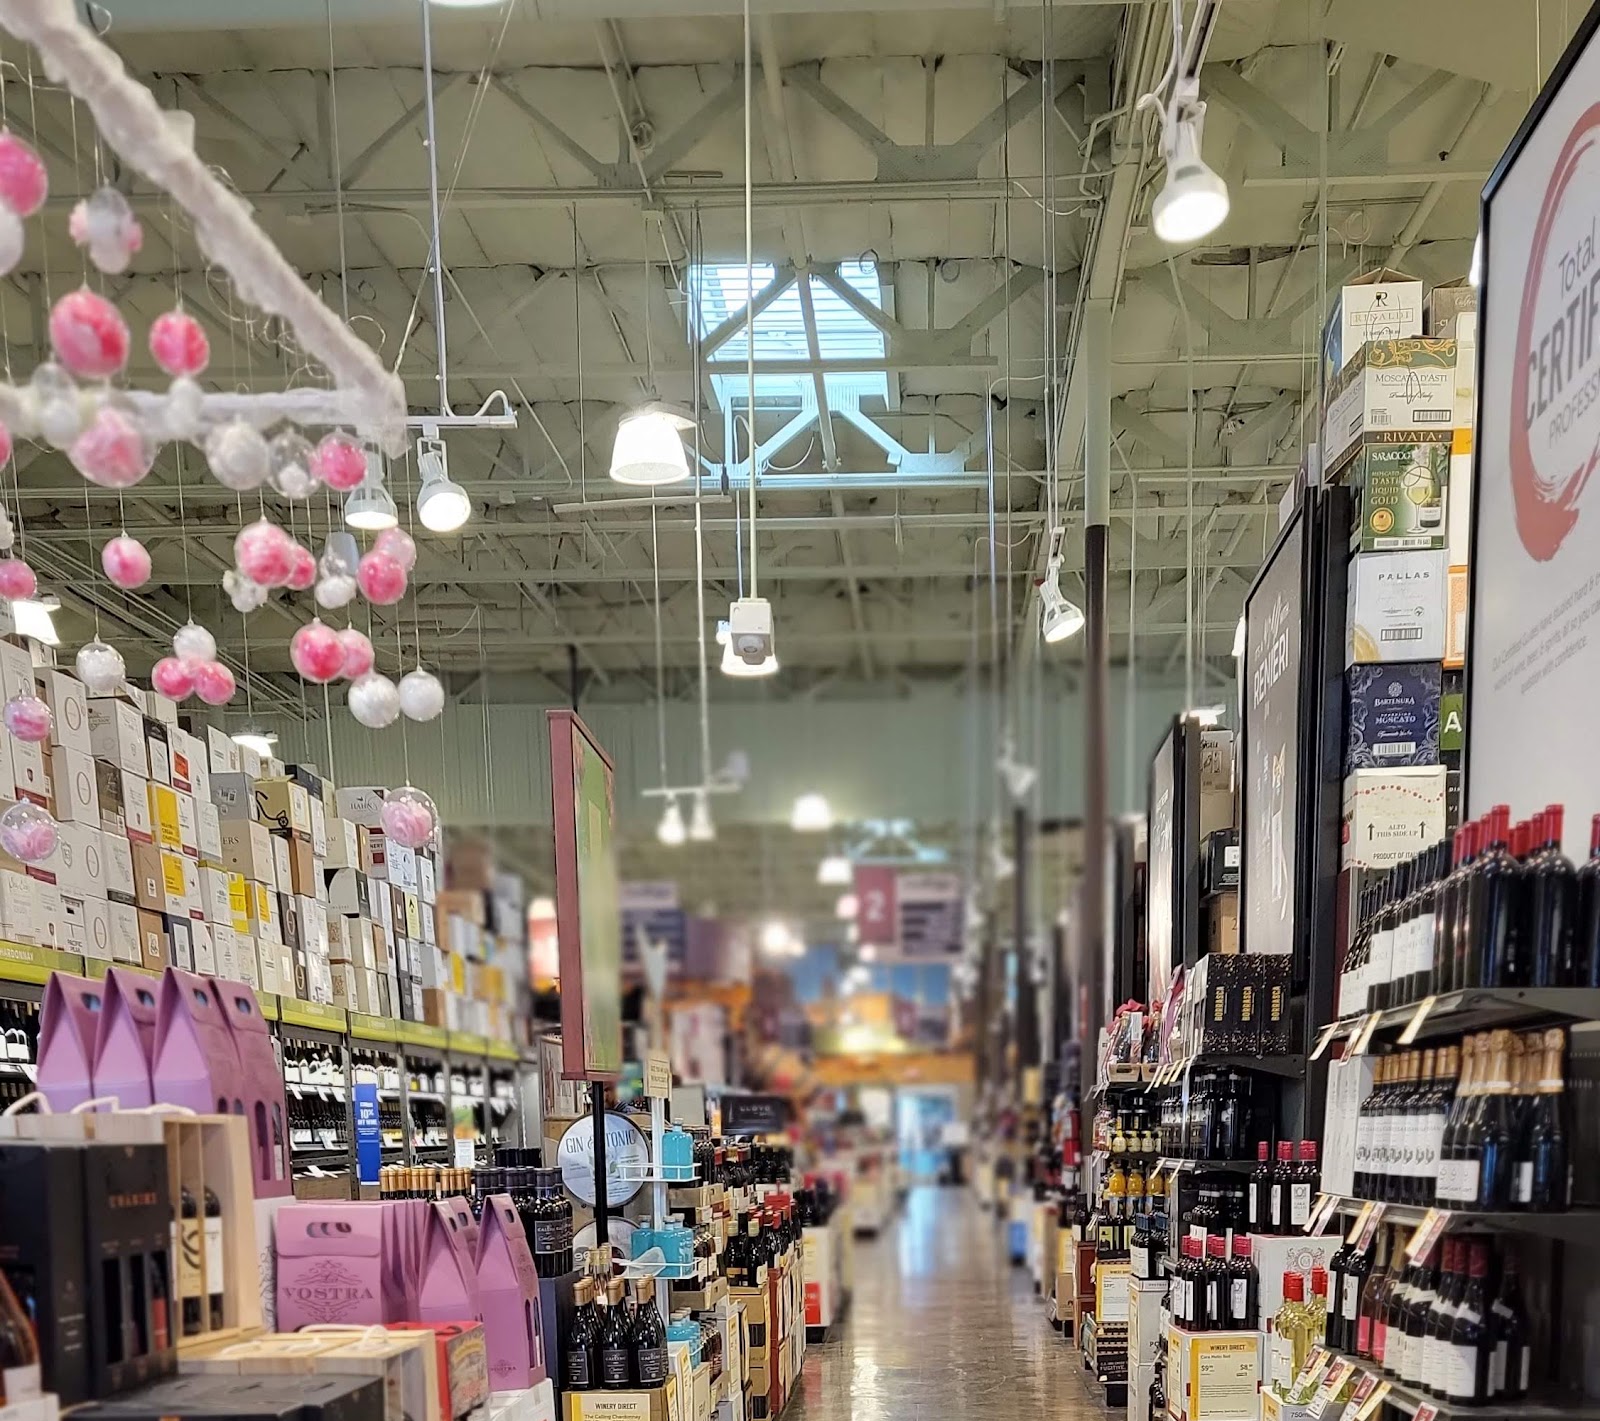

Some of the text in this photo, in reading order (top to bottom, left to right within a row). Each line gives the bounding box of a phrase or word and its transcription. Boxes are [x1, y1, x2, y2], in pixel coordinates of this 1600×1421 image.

[1558, 216, 1596, 300] Total
[1355, 310, 1410, 323] RINALDI
[1375, 373, 1448, 383] MOSCATO D'ASTI
[1383, 431, 1437, 442] RIVATA
[1371, 477, 1400, 485] D'ASTI
[1371, 487, 1399, 495] LIQUID
[1370, 496, 1399, 505] GOLD
[1378, 571, 1430, 581] PALLAS
[1253, 629, 1290, 709] RENIERI
[1375, 716, 1416, 724] MOSCATO
[1376, 830, 1392, 838] THIS
[1373, 852, 1396, 860] PRODUCT
[1214, 985, 1225, 1021] BORRASCA
[1241, 985, 1252, 1021] BORRASCA
[1270, 985, 1281, 1021] BORRASCA
[360, 1108, 375, 1119] 10%
[565, 1136, 584, 1154] GIN
[606, 1129, 637, 1148] TONIC
[281, 1287, 374, 1300] VOSTRA
